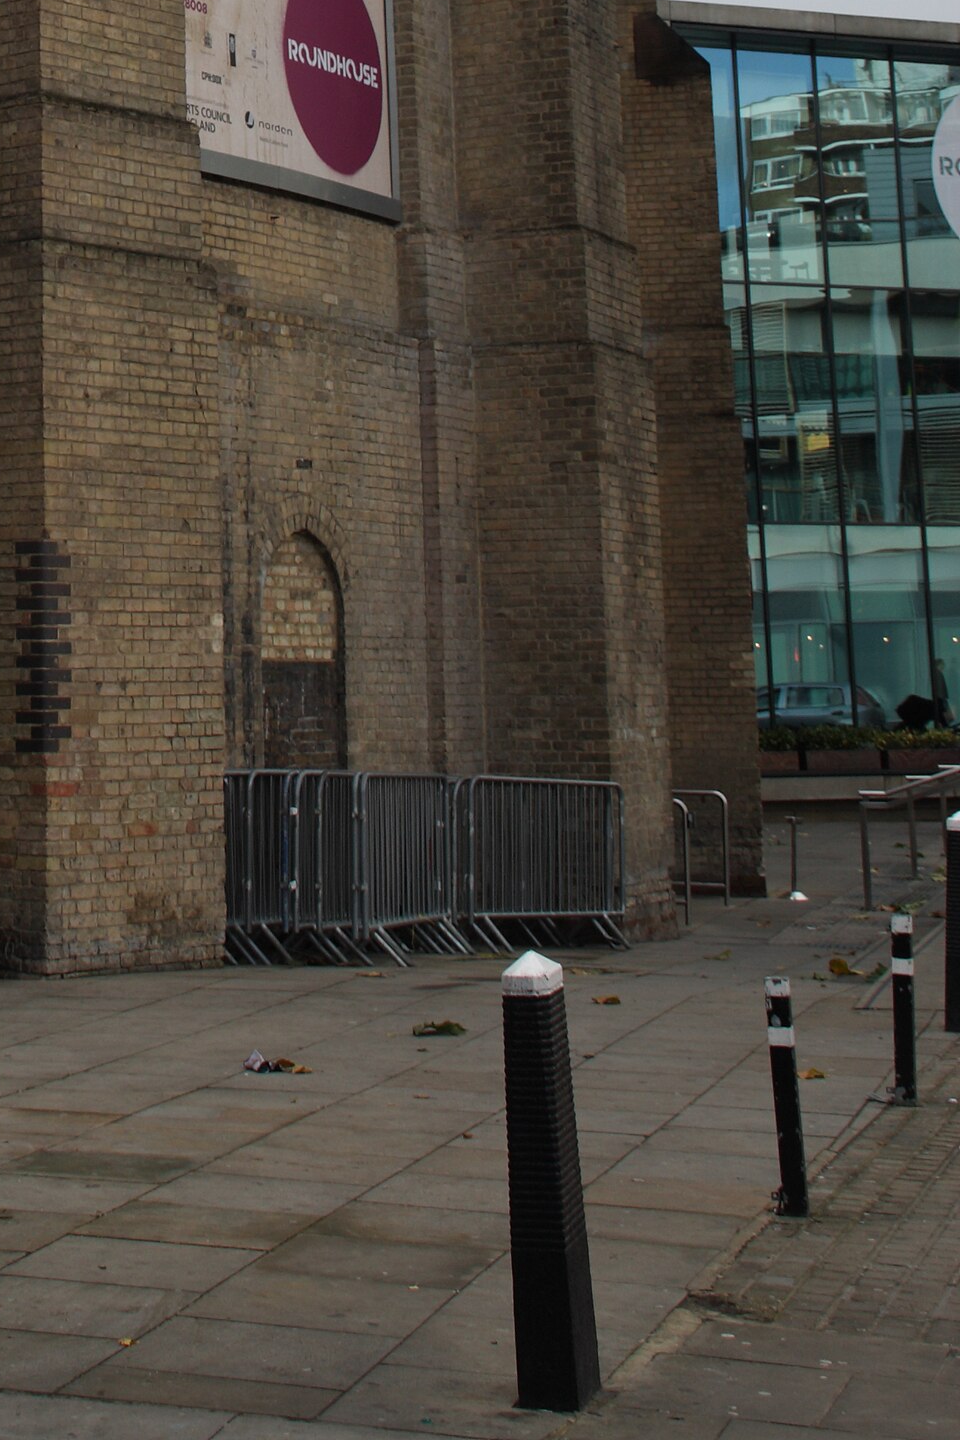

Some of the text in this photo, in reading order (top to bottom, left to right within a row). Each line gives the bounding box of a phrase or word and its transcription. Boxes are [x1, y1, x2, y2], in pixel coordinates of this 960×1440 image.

[287, 38, 379, 90] ROUNDHOUSE
[186, 104, 233, 125] RTS COUNCIL
[258, 120, 293, 137] norden
